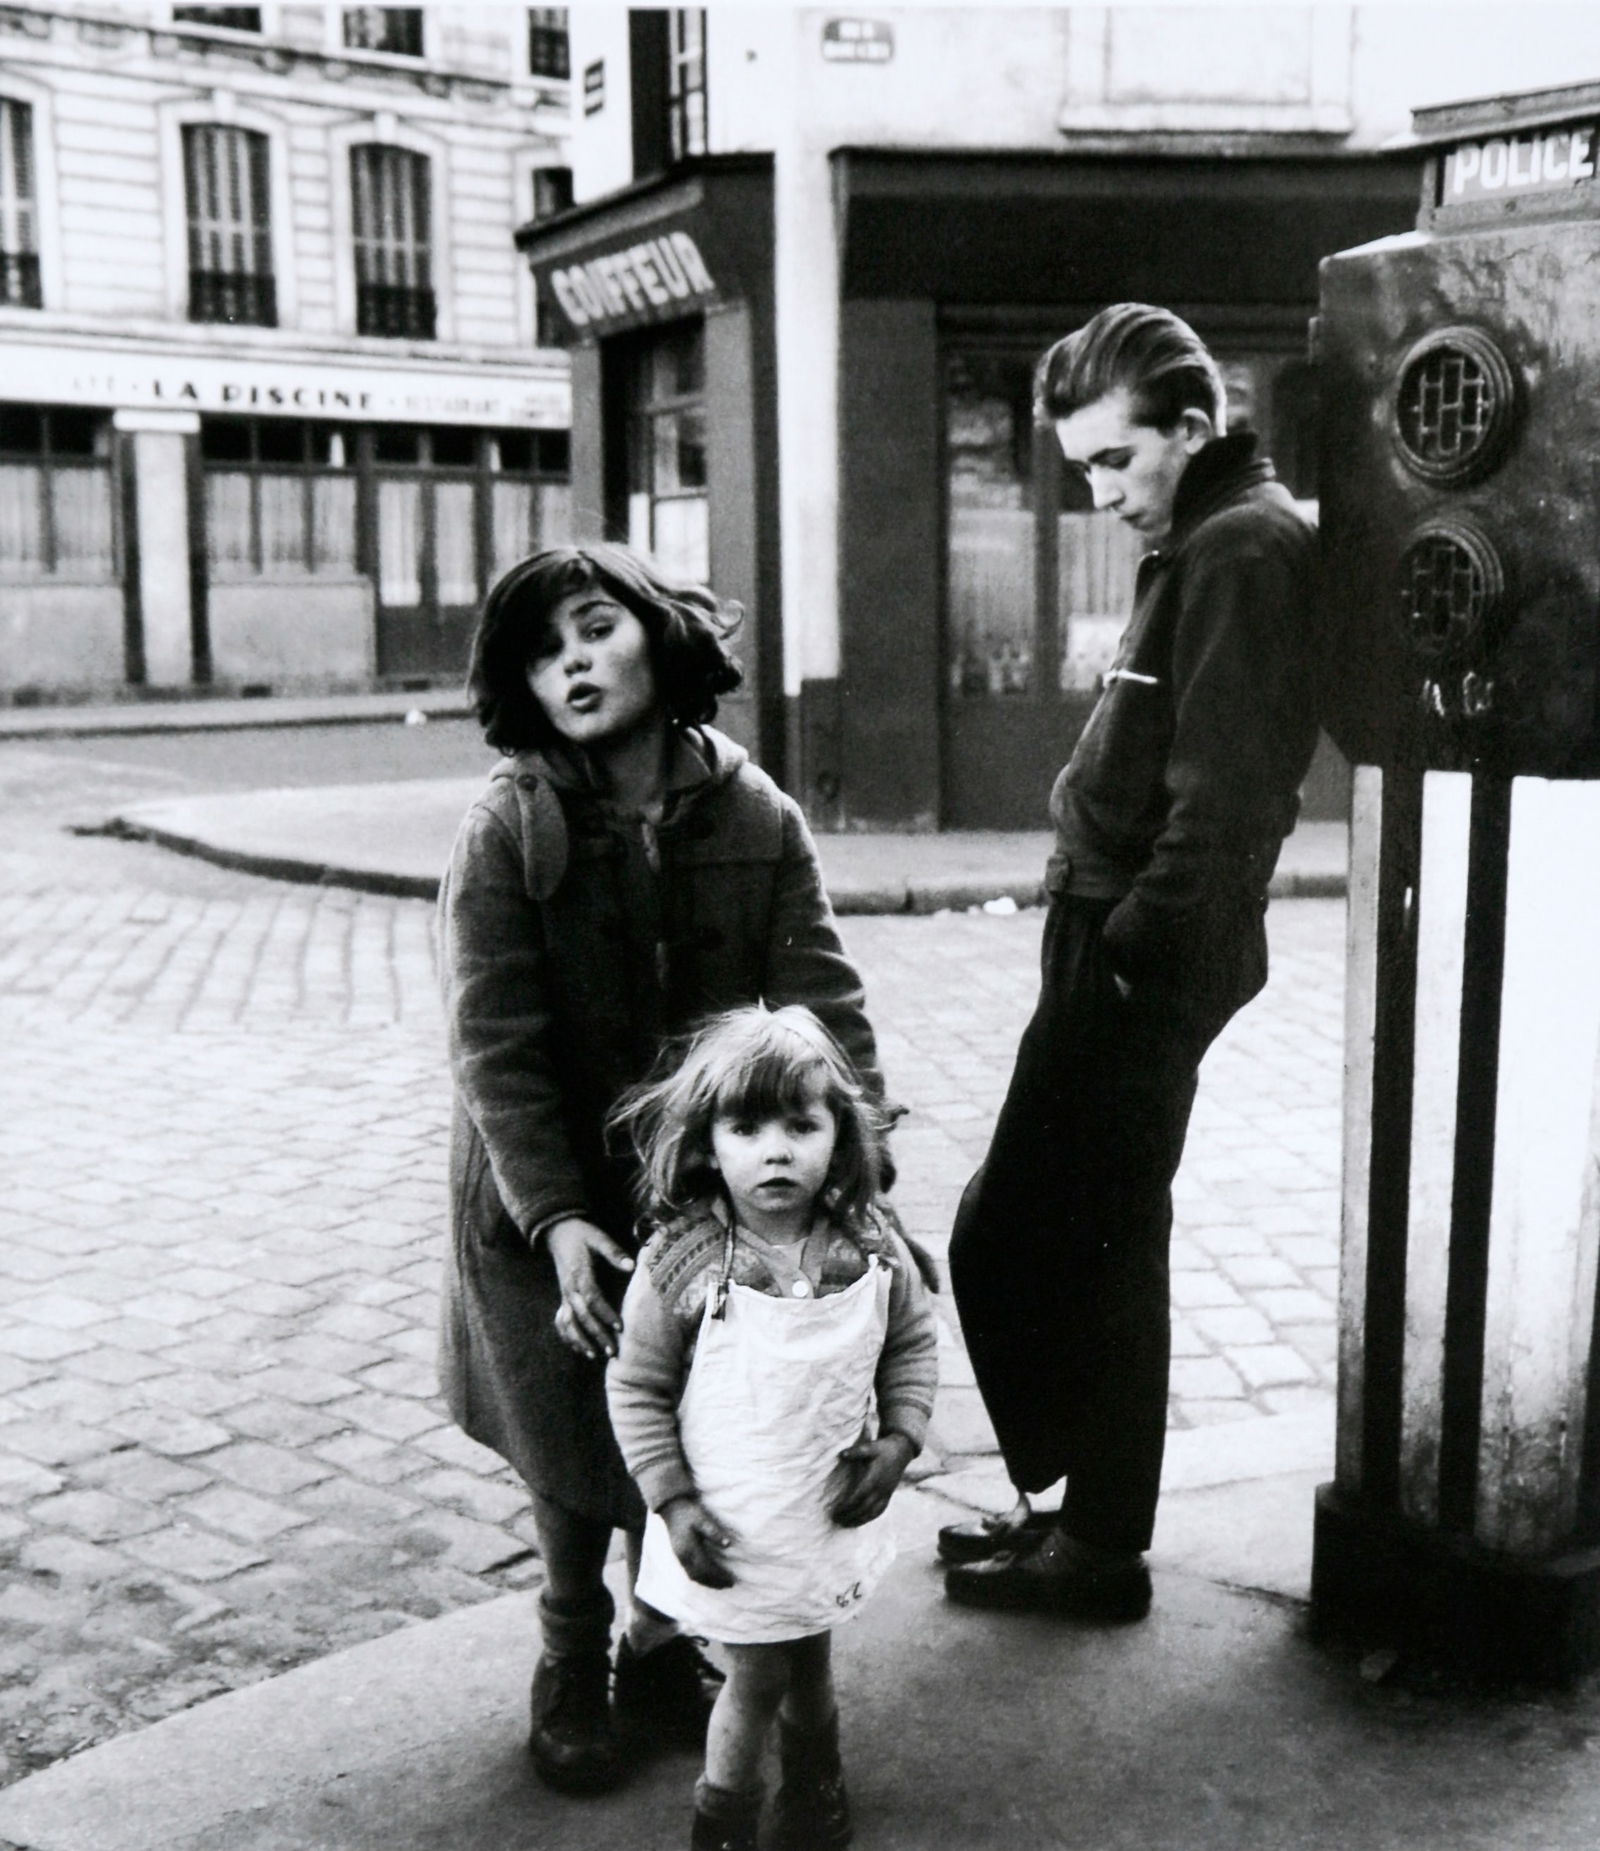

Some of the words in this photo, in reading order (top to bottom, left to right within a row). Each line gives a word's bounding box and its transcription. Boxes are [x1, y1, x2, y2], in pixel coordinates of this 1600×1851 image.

[1453, 128, 1595, 195] POLICE
[551, 231, 715, 326] COIFFEUR
[153, 378, 198, 399] LA
[222, 384, 371, 409] PISCINE
